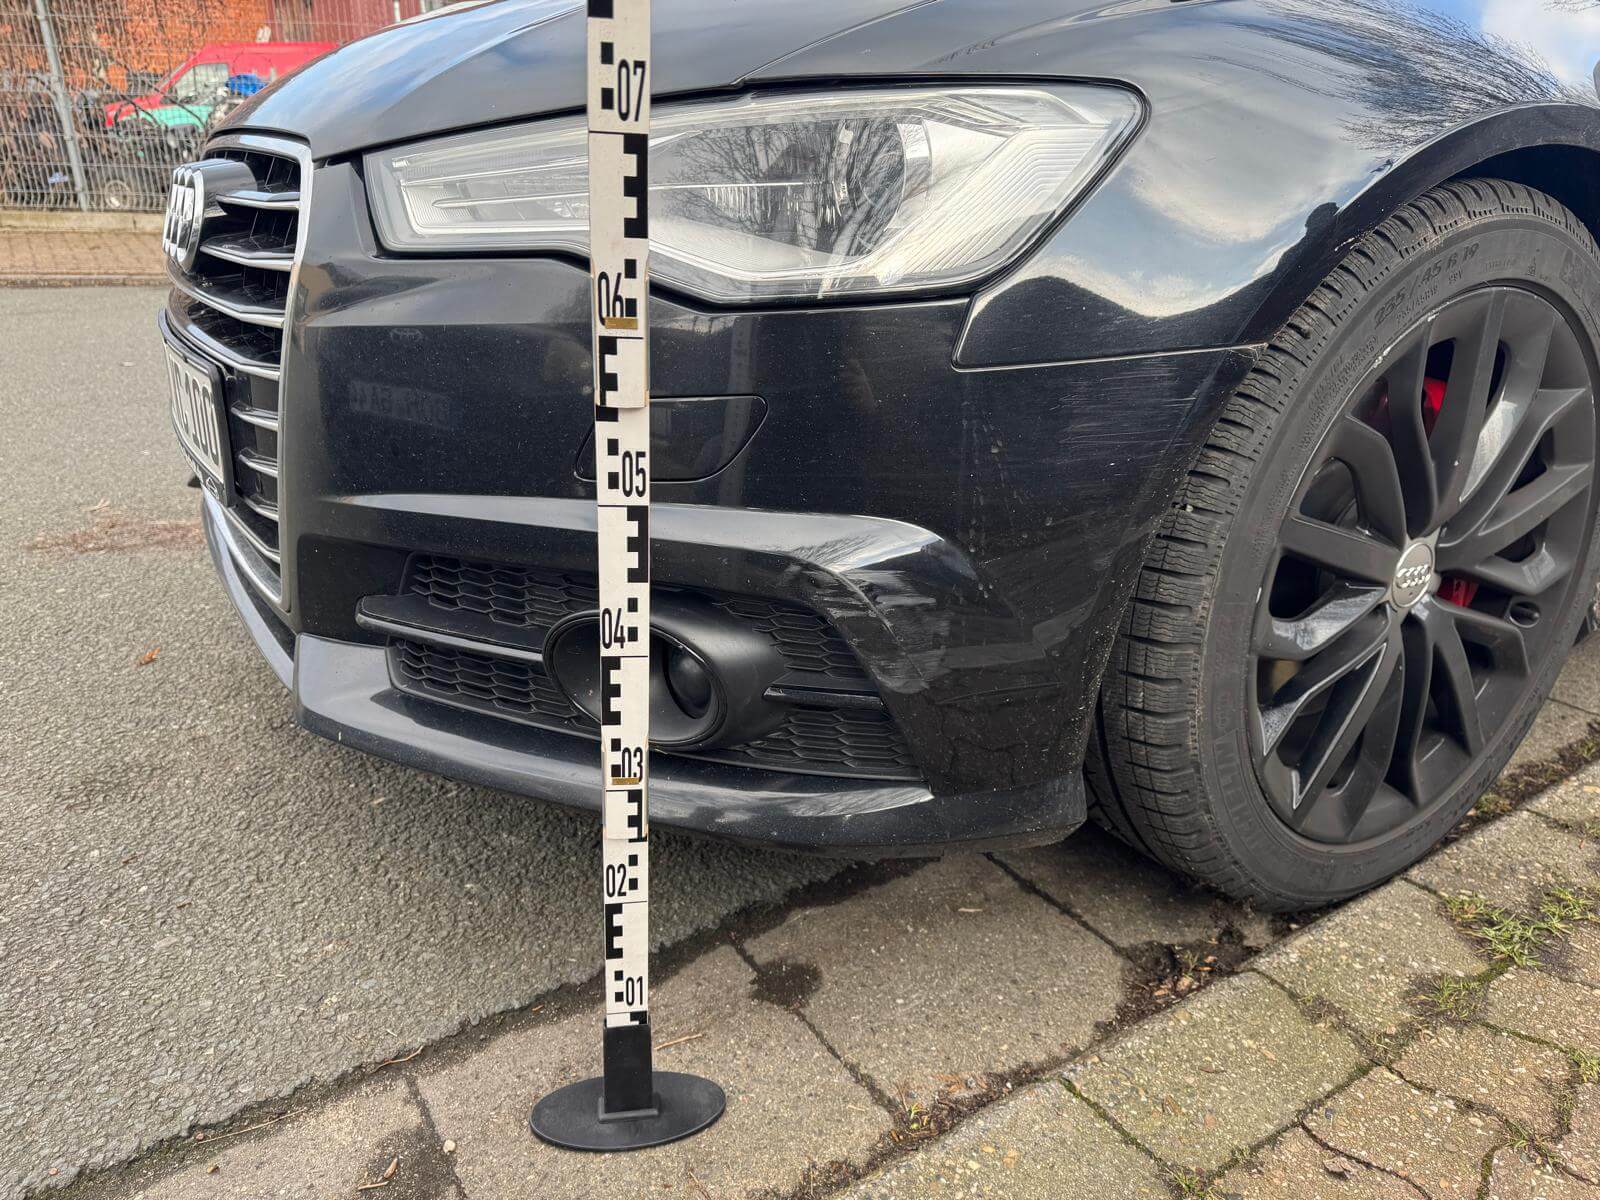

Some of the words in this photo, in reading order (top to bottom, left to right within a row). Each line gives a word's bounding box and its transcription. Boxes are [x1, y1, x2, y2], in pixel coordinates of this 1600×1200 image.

[617, 59, 646, 122] 07
[597, 271, 625, 326] 06
[622, 450, 647, 498] 05
[601, 607, 626, 650] 04
[621, 747, 643, 783] 03
[605, 863, 627, 898] 02
[625, 975, 644, 1007] 01
